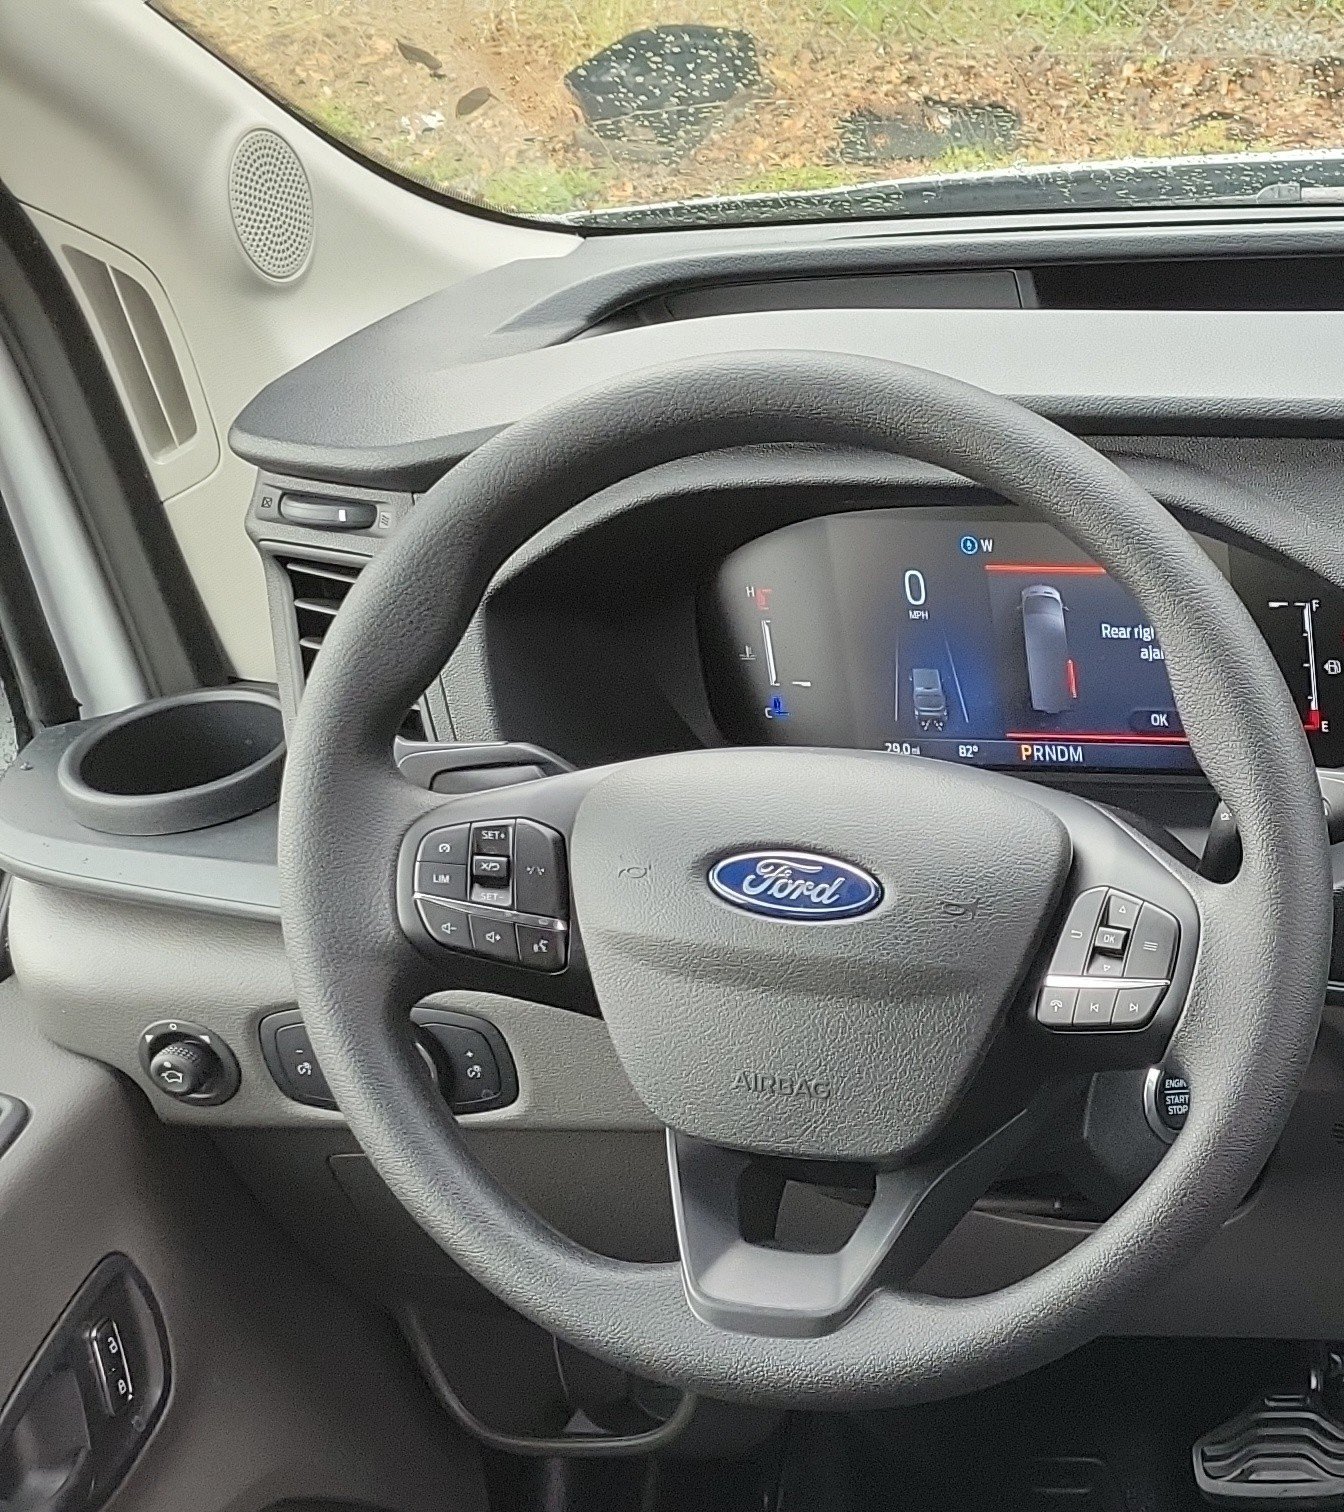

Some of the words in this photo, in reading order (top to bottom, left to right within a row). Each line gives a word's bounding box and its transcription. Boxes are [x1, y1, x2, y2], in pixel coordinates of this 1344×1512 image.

[980, 538, 993, 552] W
[745, 586, 755, 597] H
[904, 569, 926, 606] 0
[1311, 600, 1320, 612] F
[908, 610, 929, 620] MPH
[1101, 623, 1132, 639] Rear
[1134, 624, 1155, 642] rig
[1150, 713, 1169, 726] OK
[1321, 720, 1329, 732] E
[433, 874, 450, 883] LIM
[742, 858, 846, 905] Ford
[1103, 934, 1115, 944] OK
[732, 1070, 833, 1100] AIRBAG
[1165, 1094, 1189, 1105] START
[1168, 1104, 1188, 1115] STOP
